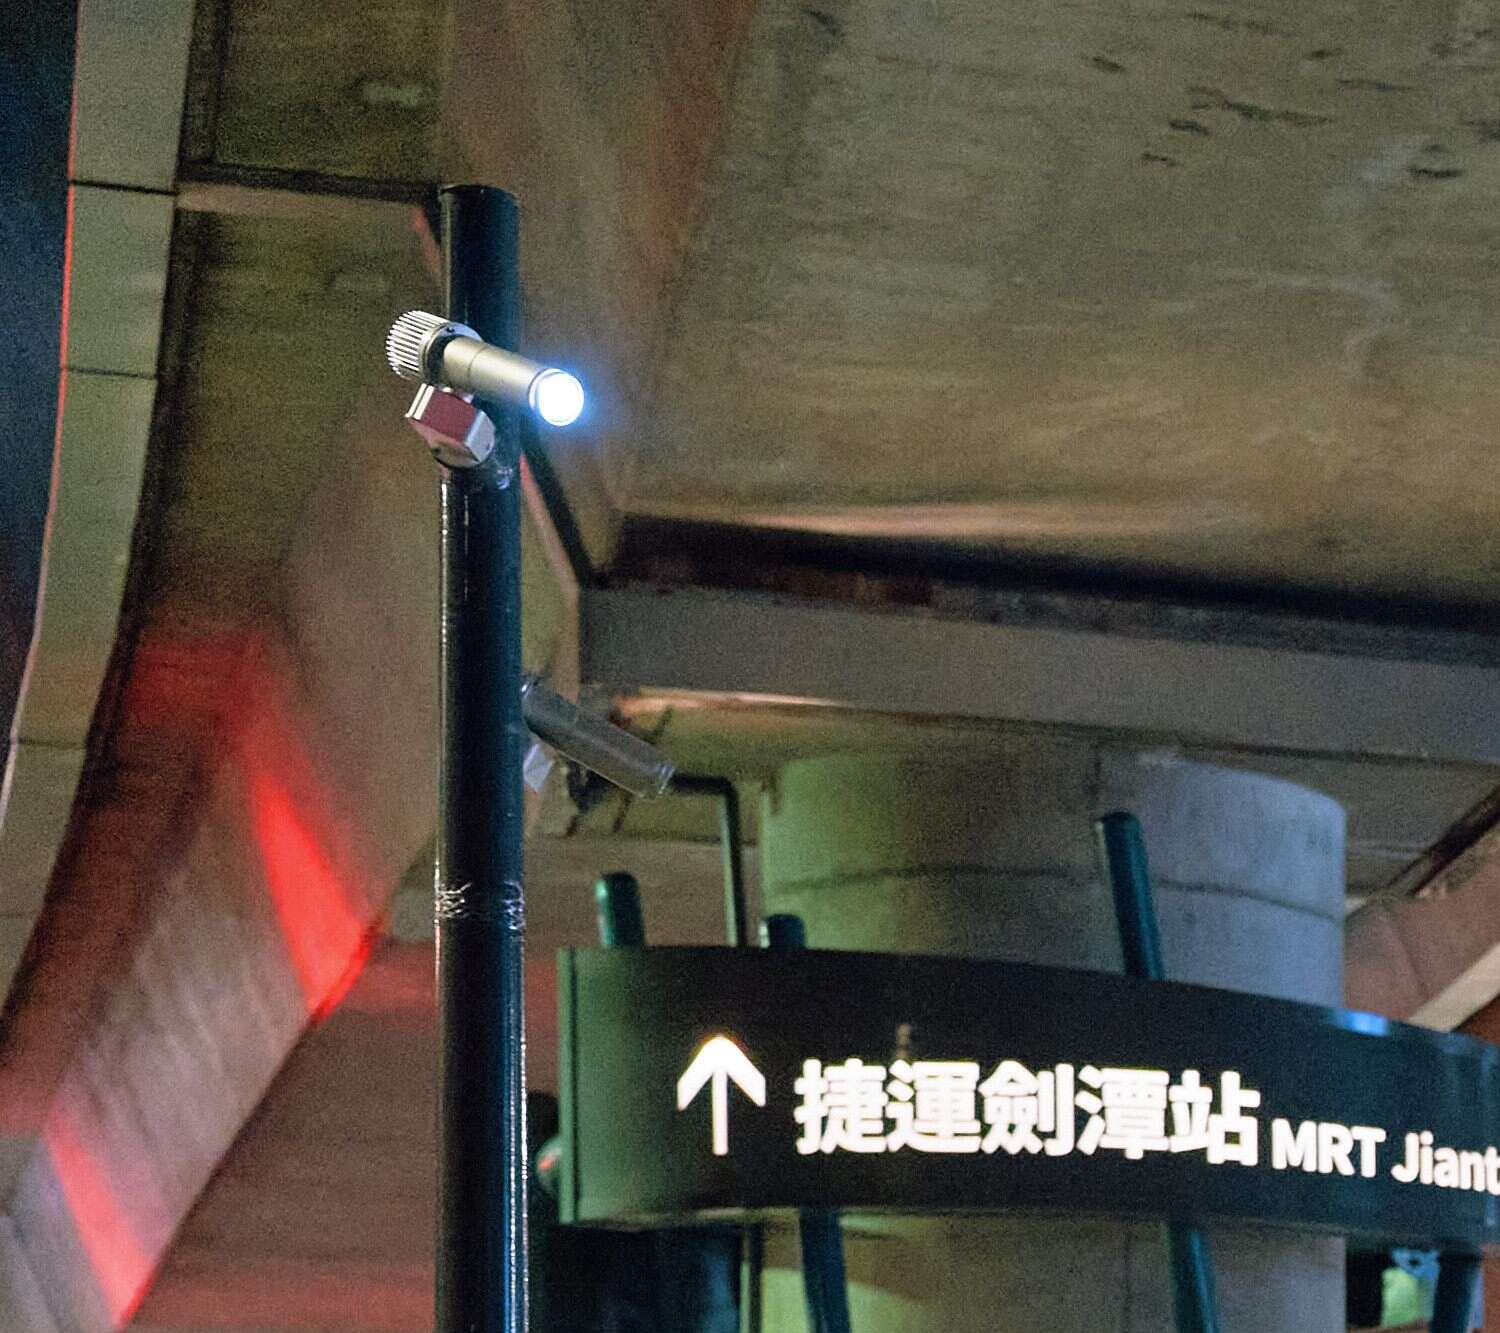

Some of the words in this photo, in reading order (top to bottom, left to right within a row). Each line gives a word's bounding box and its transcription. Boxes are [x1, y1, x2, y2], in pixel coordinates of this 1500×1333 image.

[793, 1057, 1261, 1166] 捷運劍潭站
[1270, 1117, 1386, 1178] MRT
